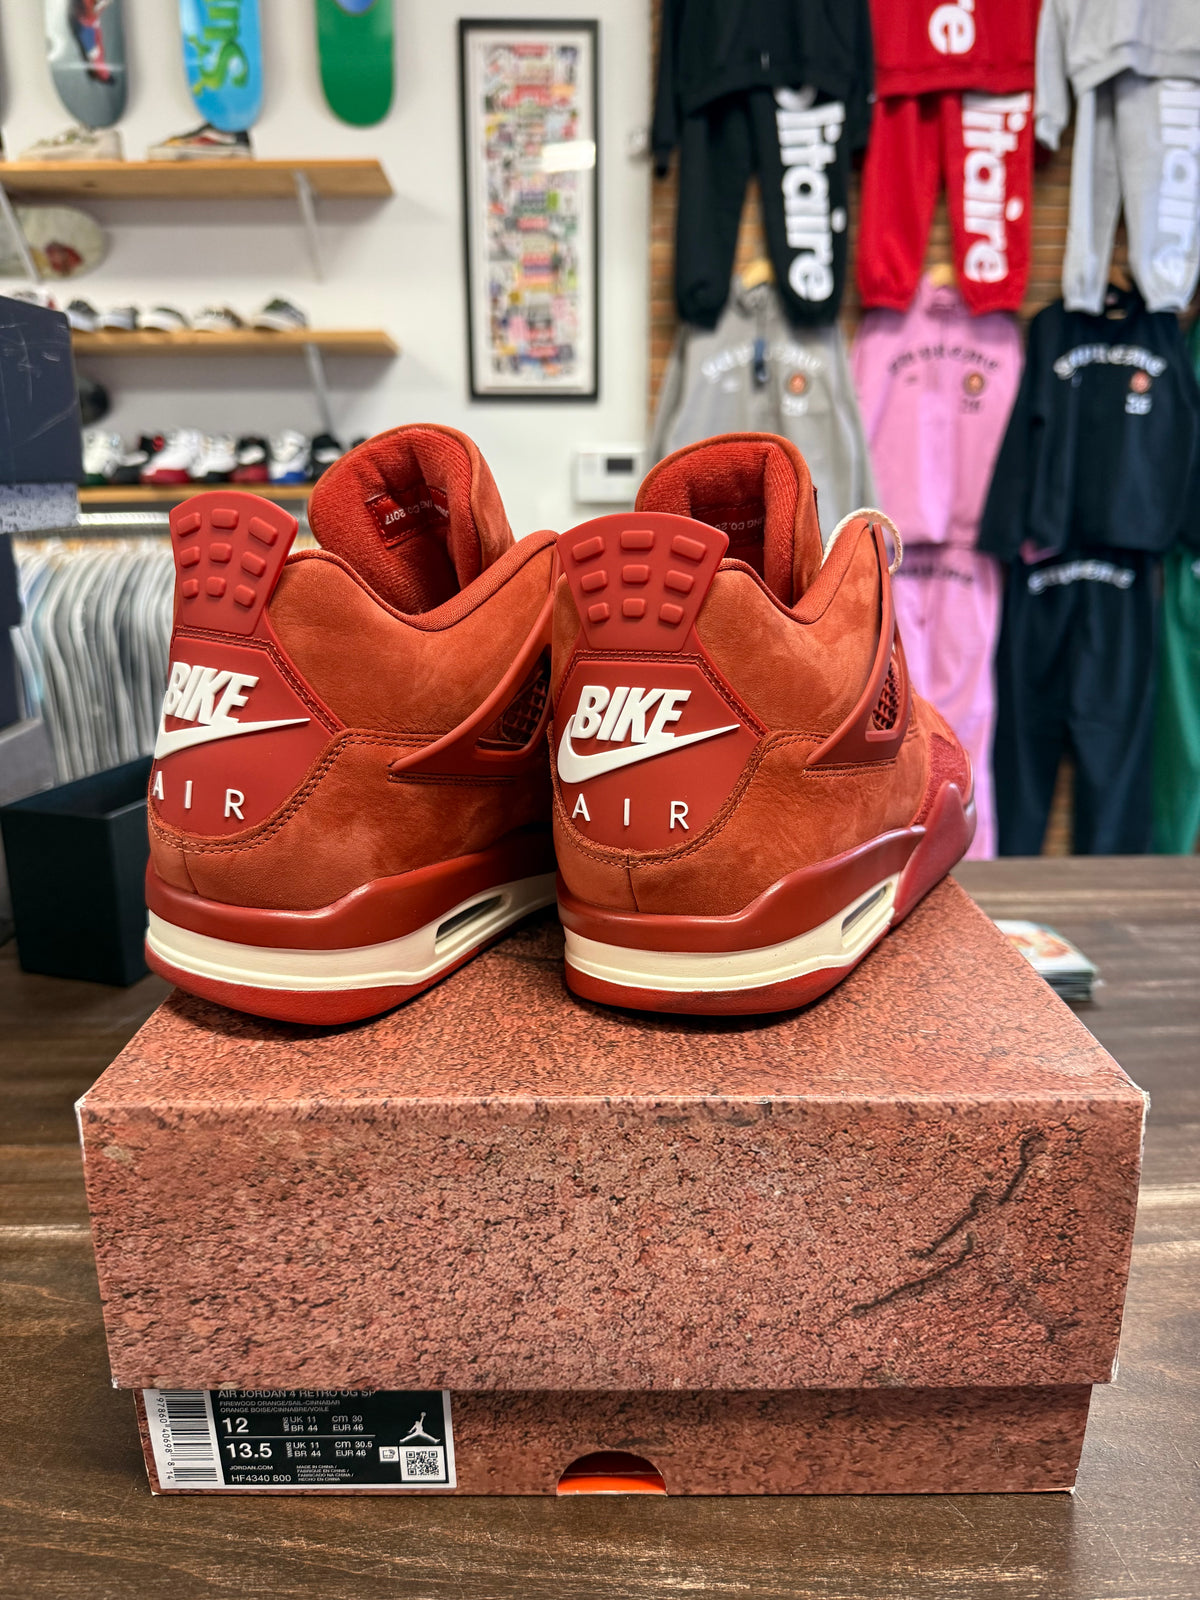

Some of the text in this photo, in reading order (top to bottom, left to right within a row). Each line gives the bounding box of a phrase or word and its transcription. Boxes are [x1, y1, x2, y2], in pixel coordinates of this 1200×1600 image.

[164, 660, 260, 726] BIKE
[569, 684, 692, 744] BIKE
[152, 768, 246, 821] AIR
[571, 792, 691, 831] AIR
[218, 1390, 237, 1398] AIR
[240, 1390, 286, 1398] JORDAN
[290, 1390, 296, 1398] 4
[222, 1417, 249, 1433] 12
[331, 1415, 363, 1423] cm 30
[332, 1423, 364, 1432] EUR 46
[226, 1442, 273, 1458] 13.5
[355, 1440, 373, 1448] 30.5
[335, 1449, 367, 1457] EUR 46
[231, 1474, 292, 1482] HF4340 800
